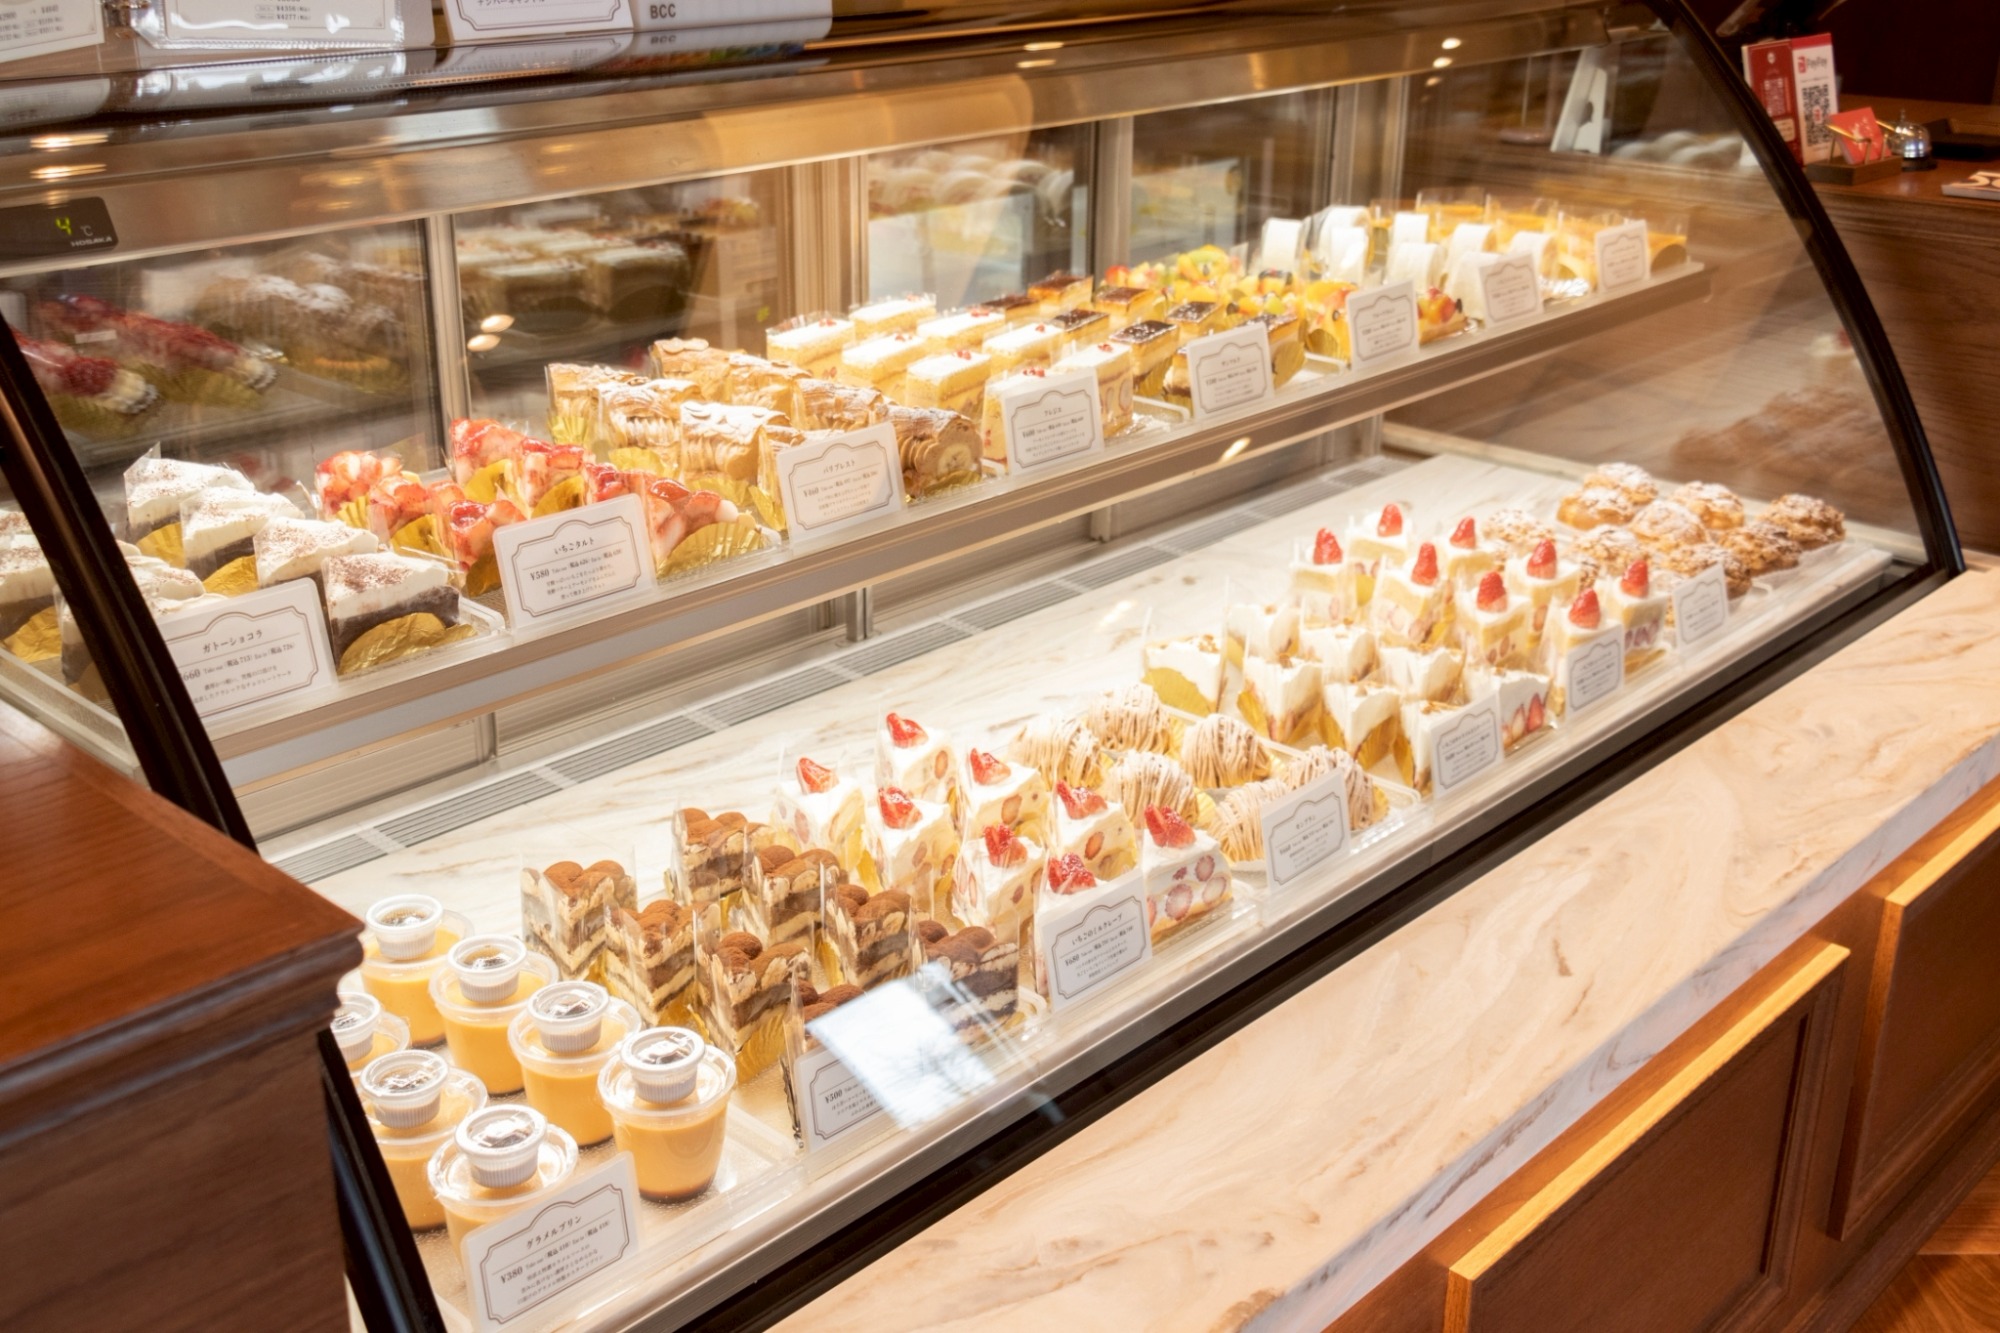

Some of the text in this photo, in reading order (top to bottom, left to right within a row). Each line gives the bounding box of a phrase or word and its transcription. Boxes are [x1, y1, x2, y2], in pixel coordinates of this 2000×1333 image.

[650, 4, 676, 19] BCC
[1807, 56, 1827, 70] PayPay
[55, 216, 72, 236] 4
[553, 536, 594, 555] いちごタルト
[529, 567, 550, 581] ¥580
[201, 629, 263, 653] ガトーショコラ
[182, 668, 201, 681] 660
[824, 1088, 842, 1104] ¥500
[525, 1214, 582, 1249] グラメルプリン
[500, 1265, 523, 1285] ¥380
